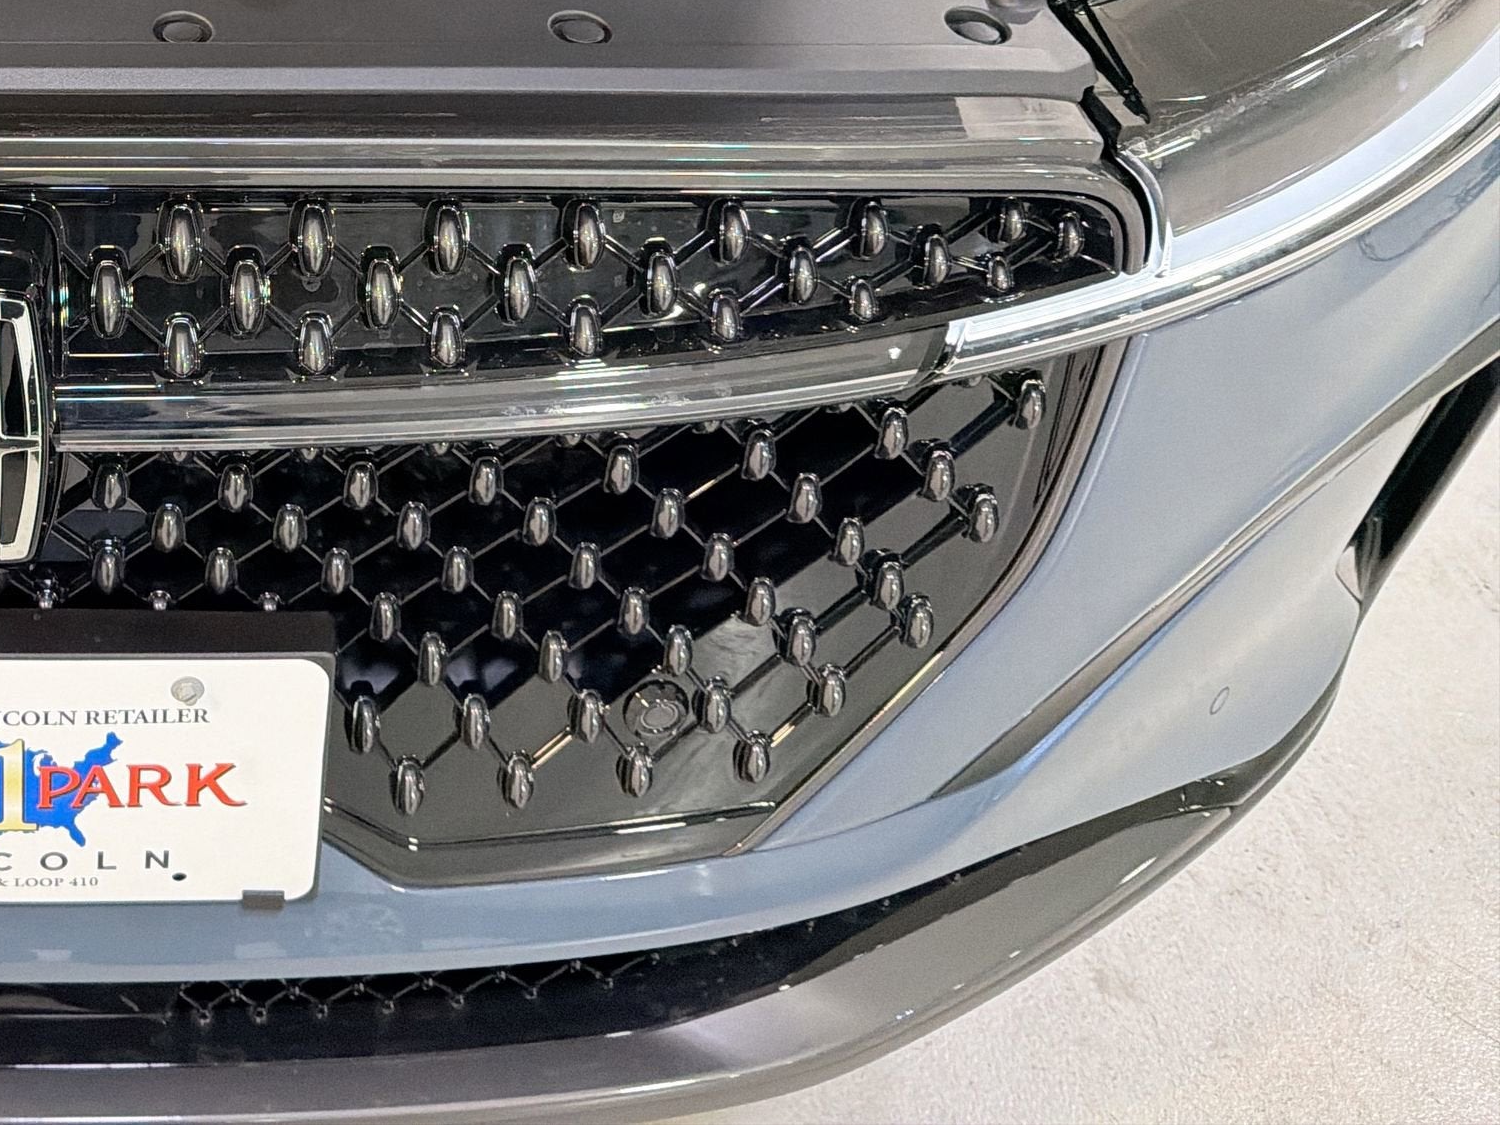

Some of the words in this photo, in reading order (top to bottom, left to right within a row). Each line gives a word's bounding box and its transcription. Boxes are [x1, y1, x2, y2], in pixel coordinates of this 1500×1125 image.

[85, 708, 211, 725] RETAILER
[36, 762, 248, 810] PARK
[15, 876, 64, 887] LOOP
[68, 875, 99, 887] 410
